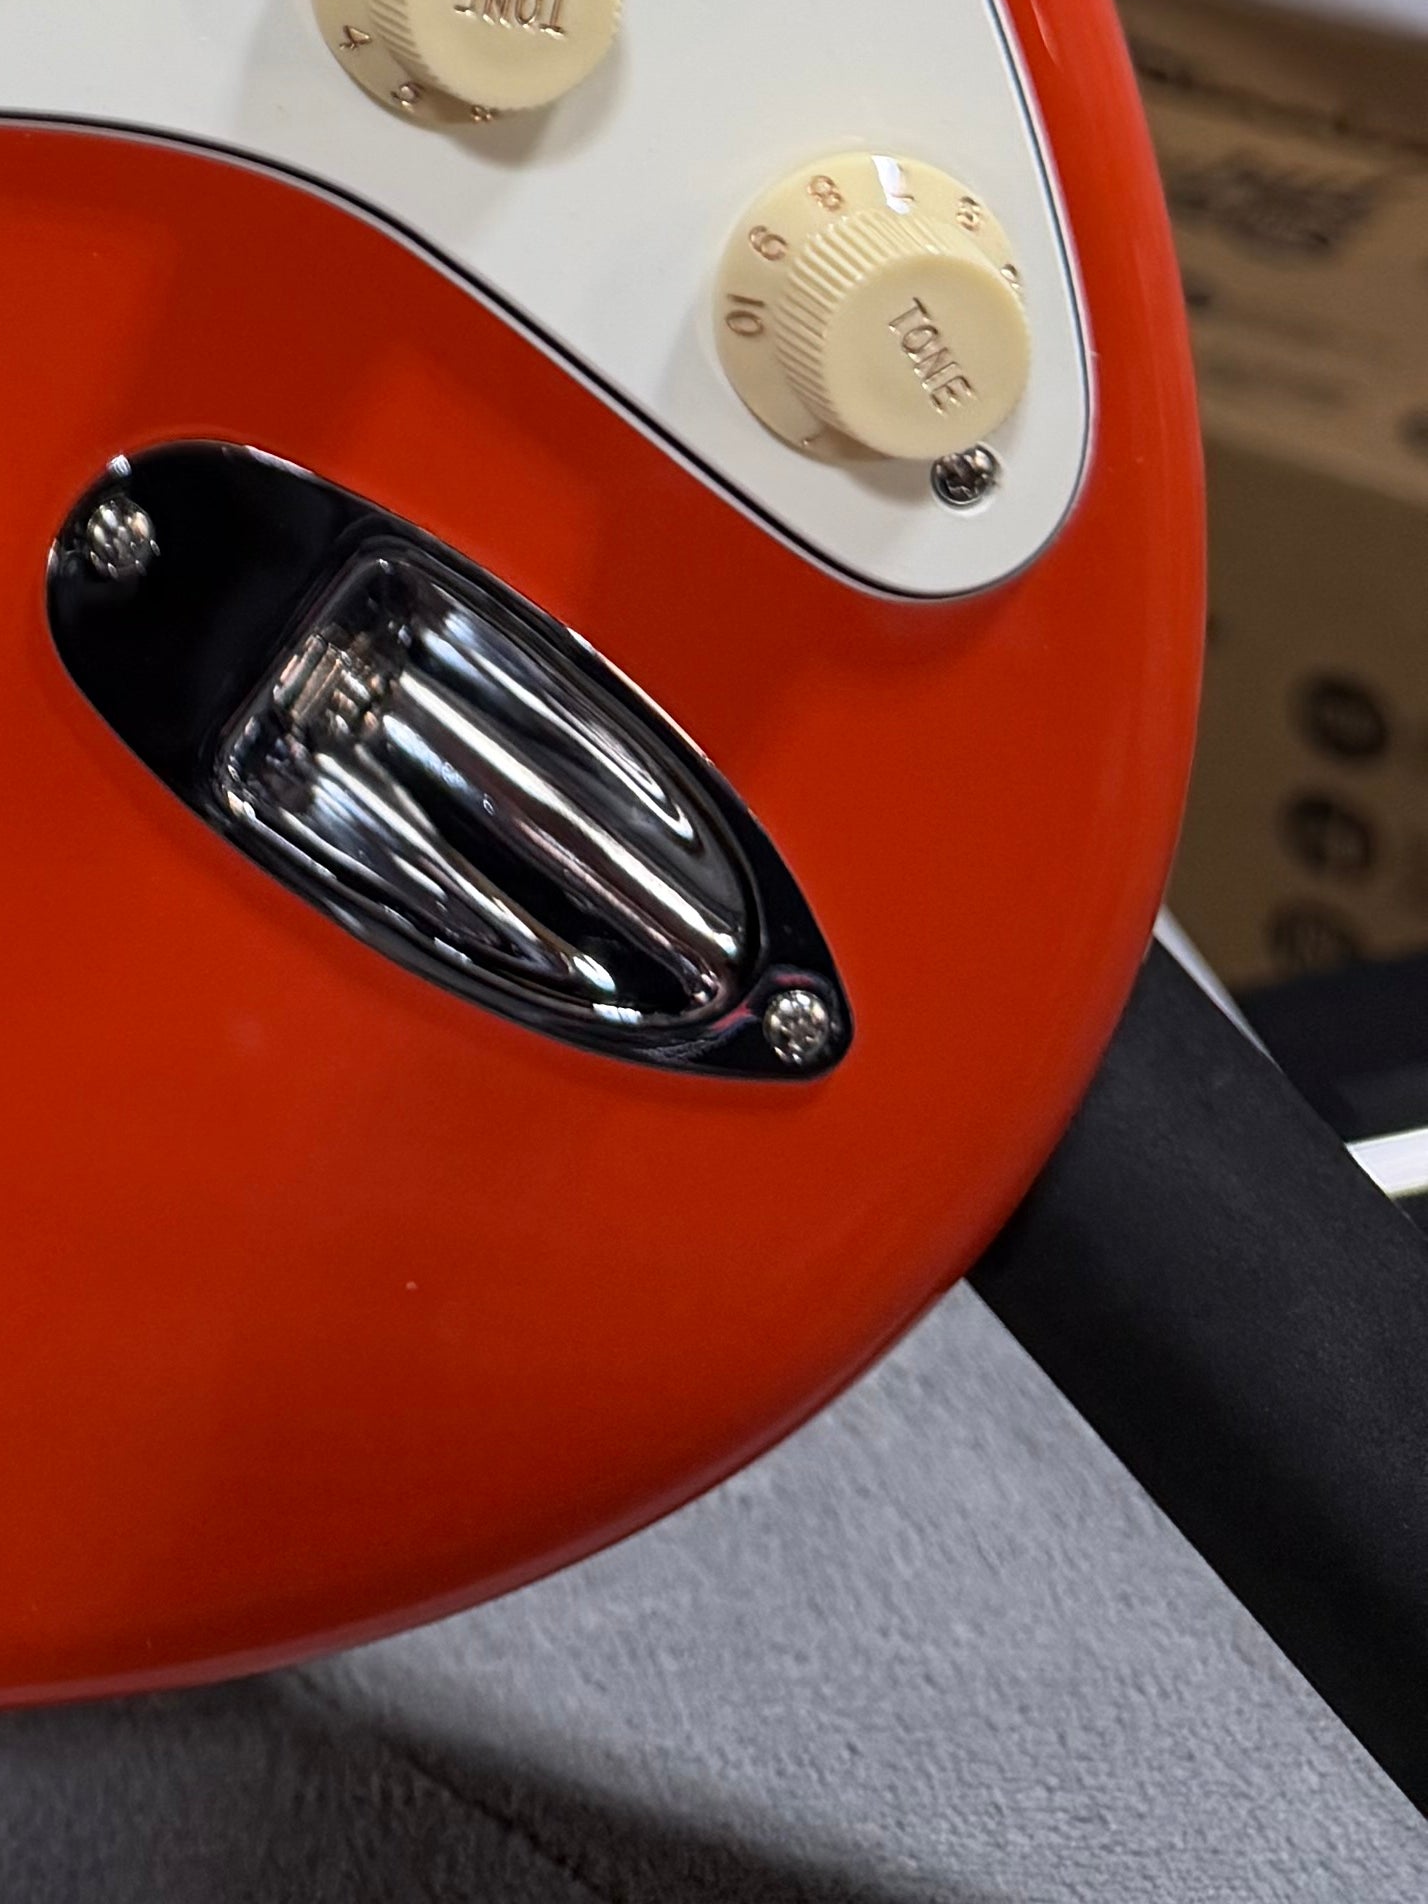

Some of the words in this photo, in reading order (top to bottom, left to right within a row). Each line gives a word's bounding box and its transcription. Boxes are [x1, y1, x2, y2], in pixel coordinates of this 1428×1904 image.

[339, 24, 373, 51] 4
[807, 174, 846, 213] 8
[724, 292, 766, 338] 10
[887, 296, 978, 417] TONE
